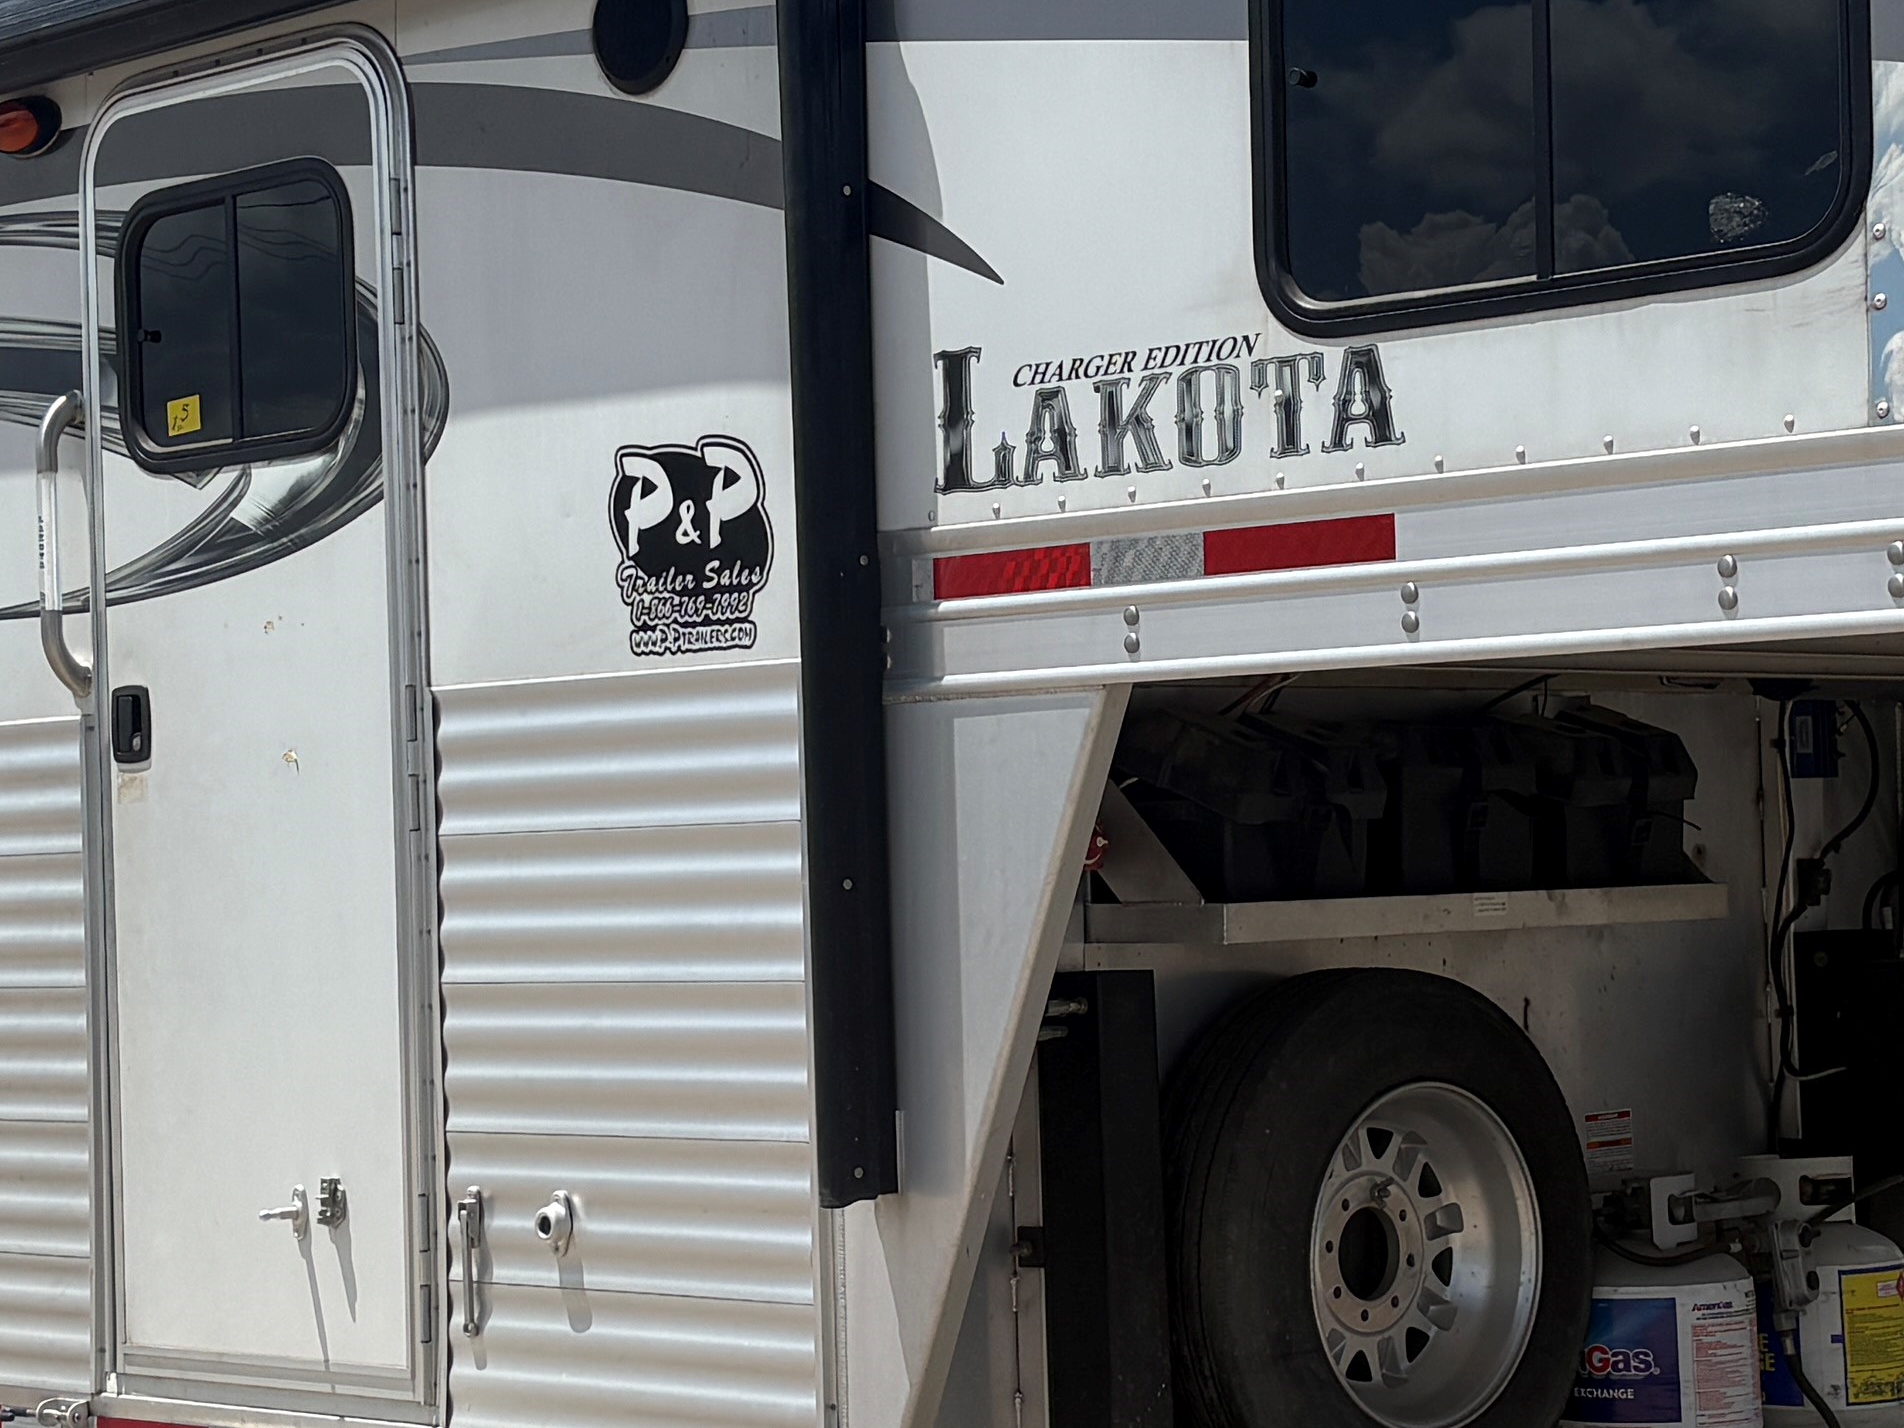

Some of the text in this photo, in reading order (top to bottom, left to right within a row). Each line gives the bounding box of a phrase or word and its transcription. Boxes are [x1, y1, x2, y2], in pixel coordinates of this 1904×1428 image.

[1012, 332, 1263, 388] CHARGER EDITION
[933, 343, 1407, 495] LAKOTA
[620, 559, 763, 599] Trailer Sales
[635, 591, 748, 619] 1-866-769-7992
[1573, 1386, 1636, 1401] EXCHANGE
